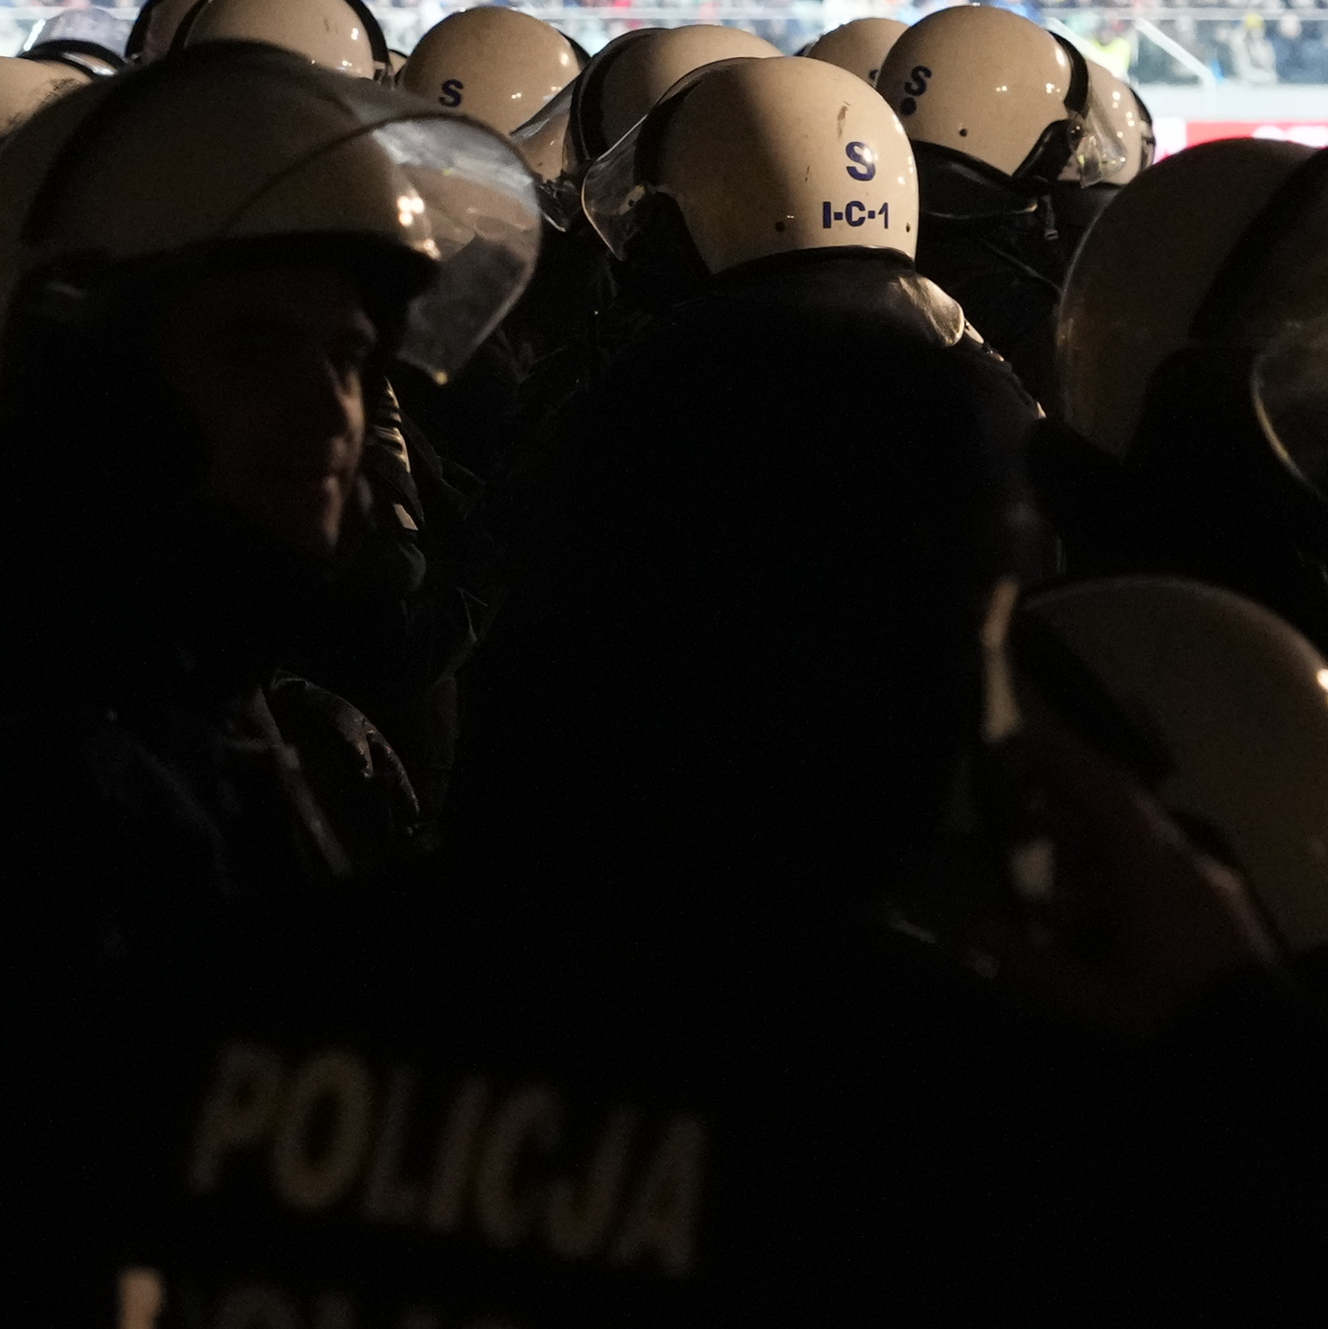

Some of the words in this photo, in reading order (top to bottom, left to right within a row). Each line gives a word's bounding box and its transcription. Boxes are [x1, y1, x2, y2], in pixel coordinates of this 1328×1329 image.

[439, 78, 464, 107] S
[904, 65, 932, 96] S
[845, 141, 876, 181] S
[823, 200, 889, 229] I-C-1
[180, 1036, 708, 1274] POLICJA
